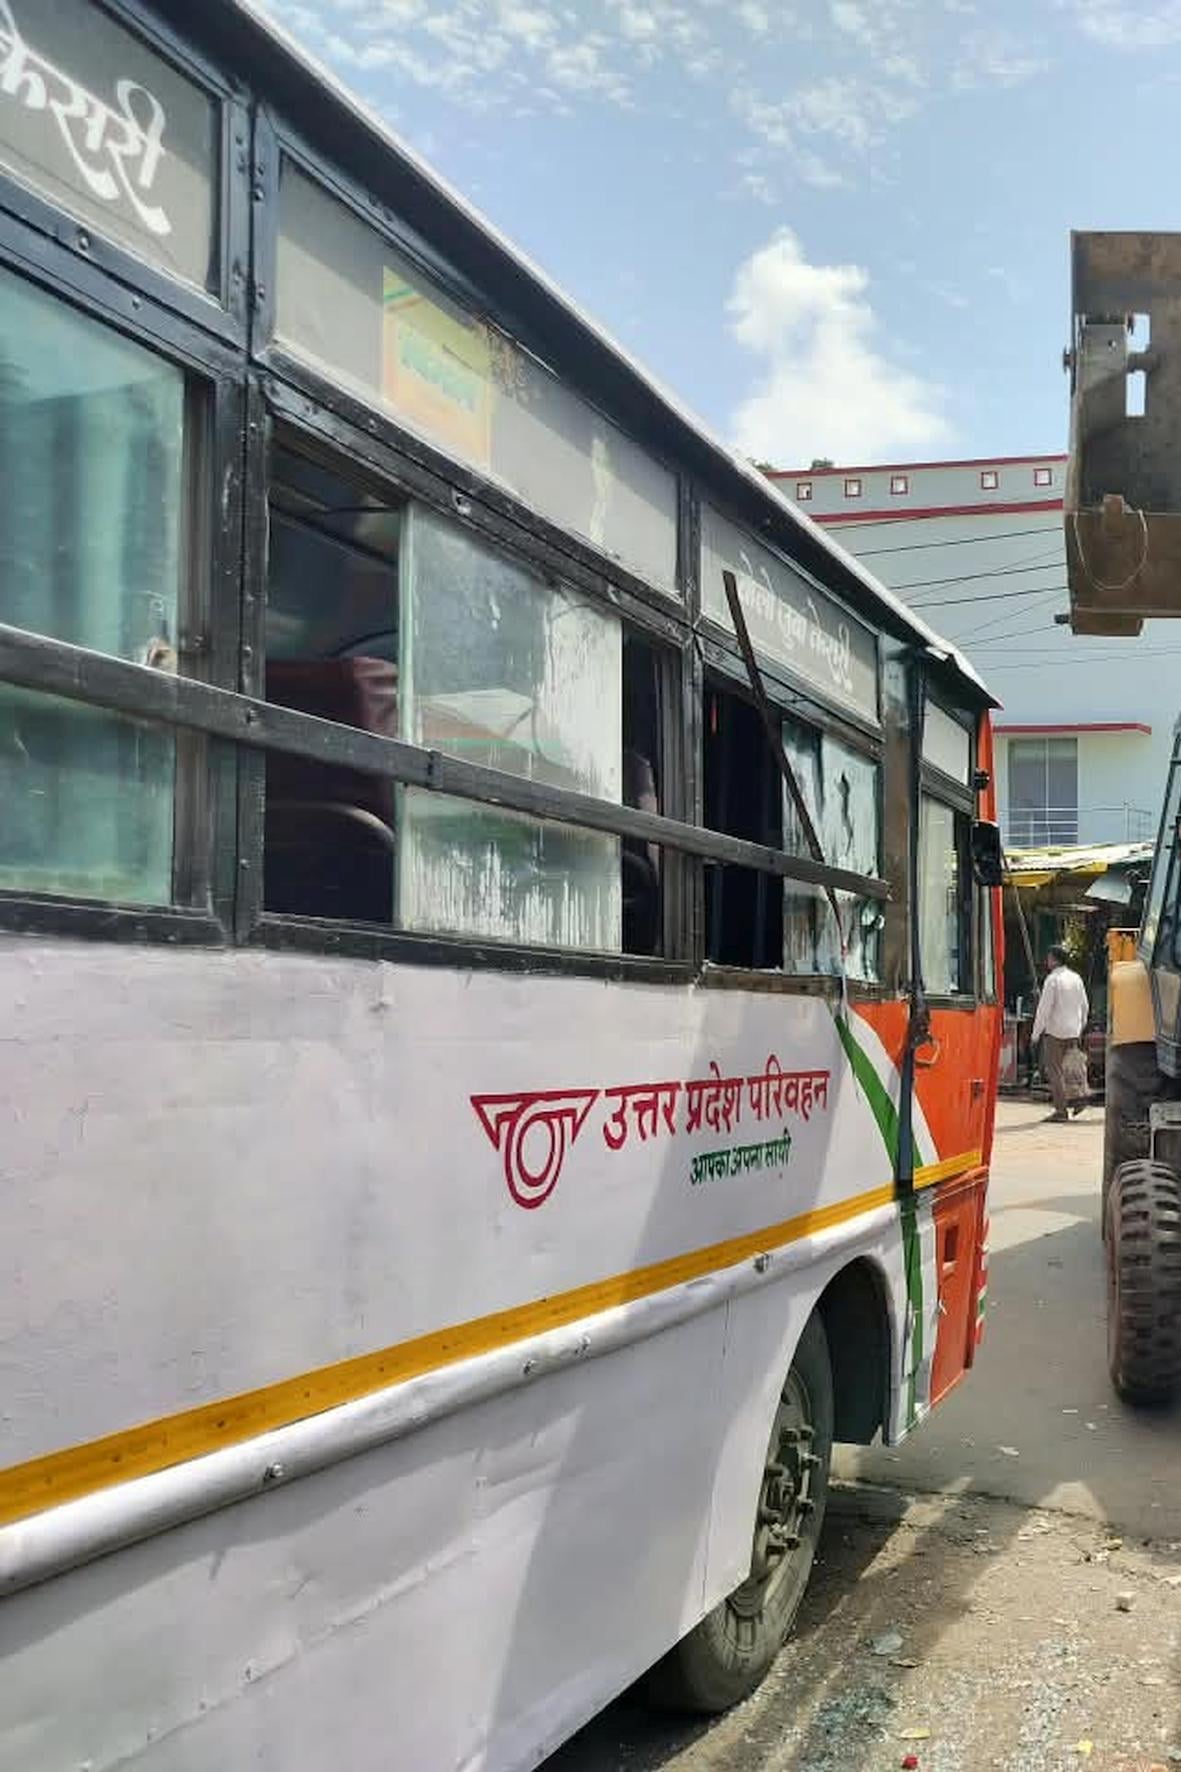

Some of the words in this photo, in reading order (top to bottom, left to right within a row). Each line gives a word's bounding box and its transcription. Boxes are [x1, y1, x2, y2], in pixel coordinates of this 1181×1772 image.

[602, 1079, 682, 1151] उत्तर
[685, 1060, 744, 1135] प्रदेश
[747, 1053, 831, 1122] परिवहन
[689, 1149, 731, 1185] आपका
[730, 1143, 764, 1177] अपना
[764, 1127, 792, 1168] साथी
